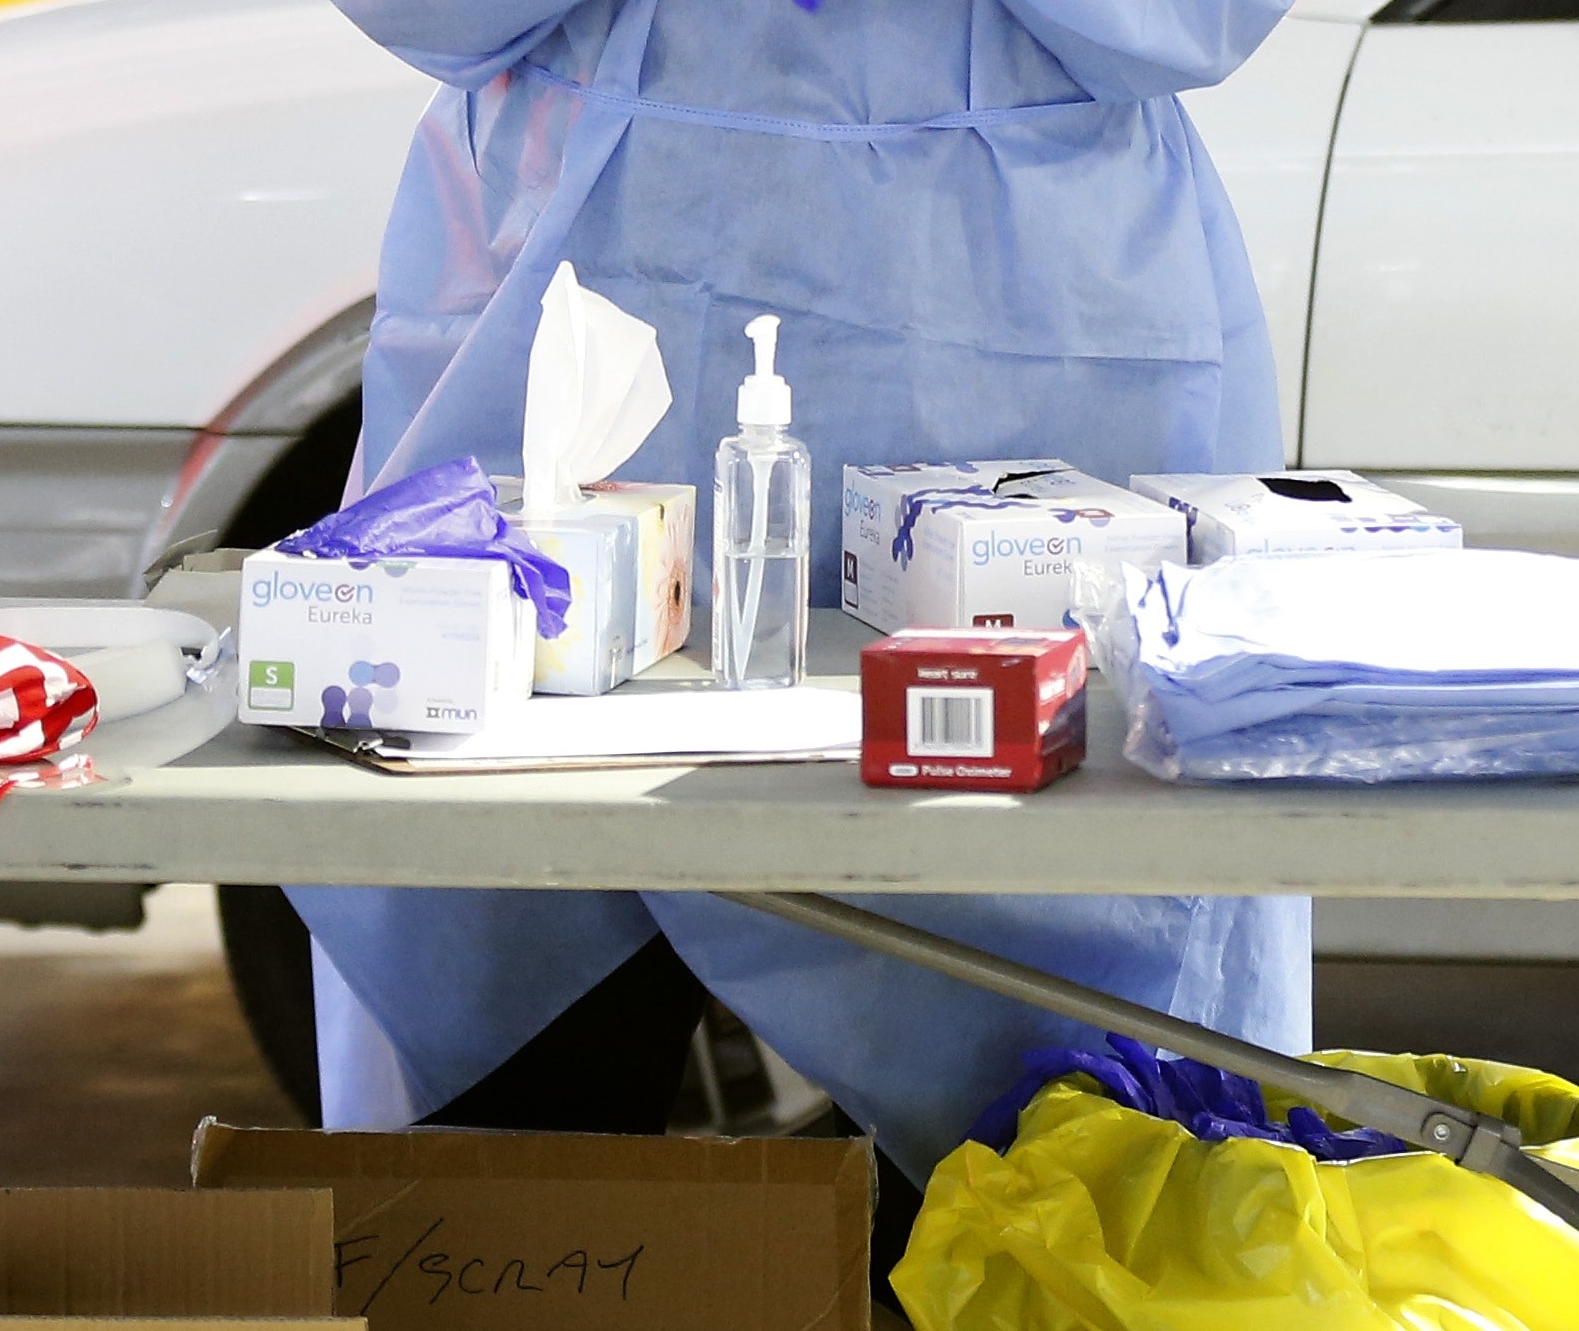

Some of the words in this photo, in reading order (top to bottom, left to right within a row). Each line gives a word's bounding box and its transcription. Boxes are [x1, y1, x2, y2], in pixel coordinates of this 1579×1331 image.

[972, 530, 1082, 566] gloveon
[1024, 559, 1074, 576] Eurek
[252, 570, 374, 607] gloveon
[308, 605, 373, 625] Eureka
[265, 667, 279, 685] S
